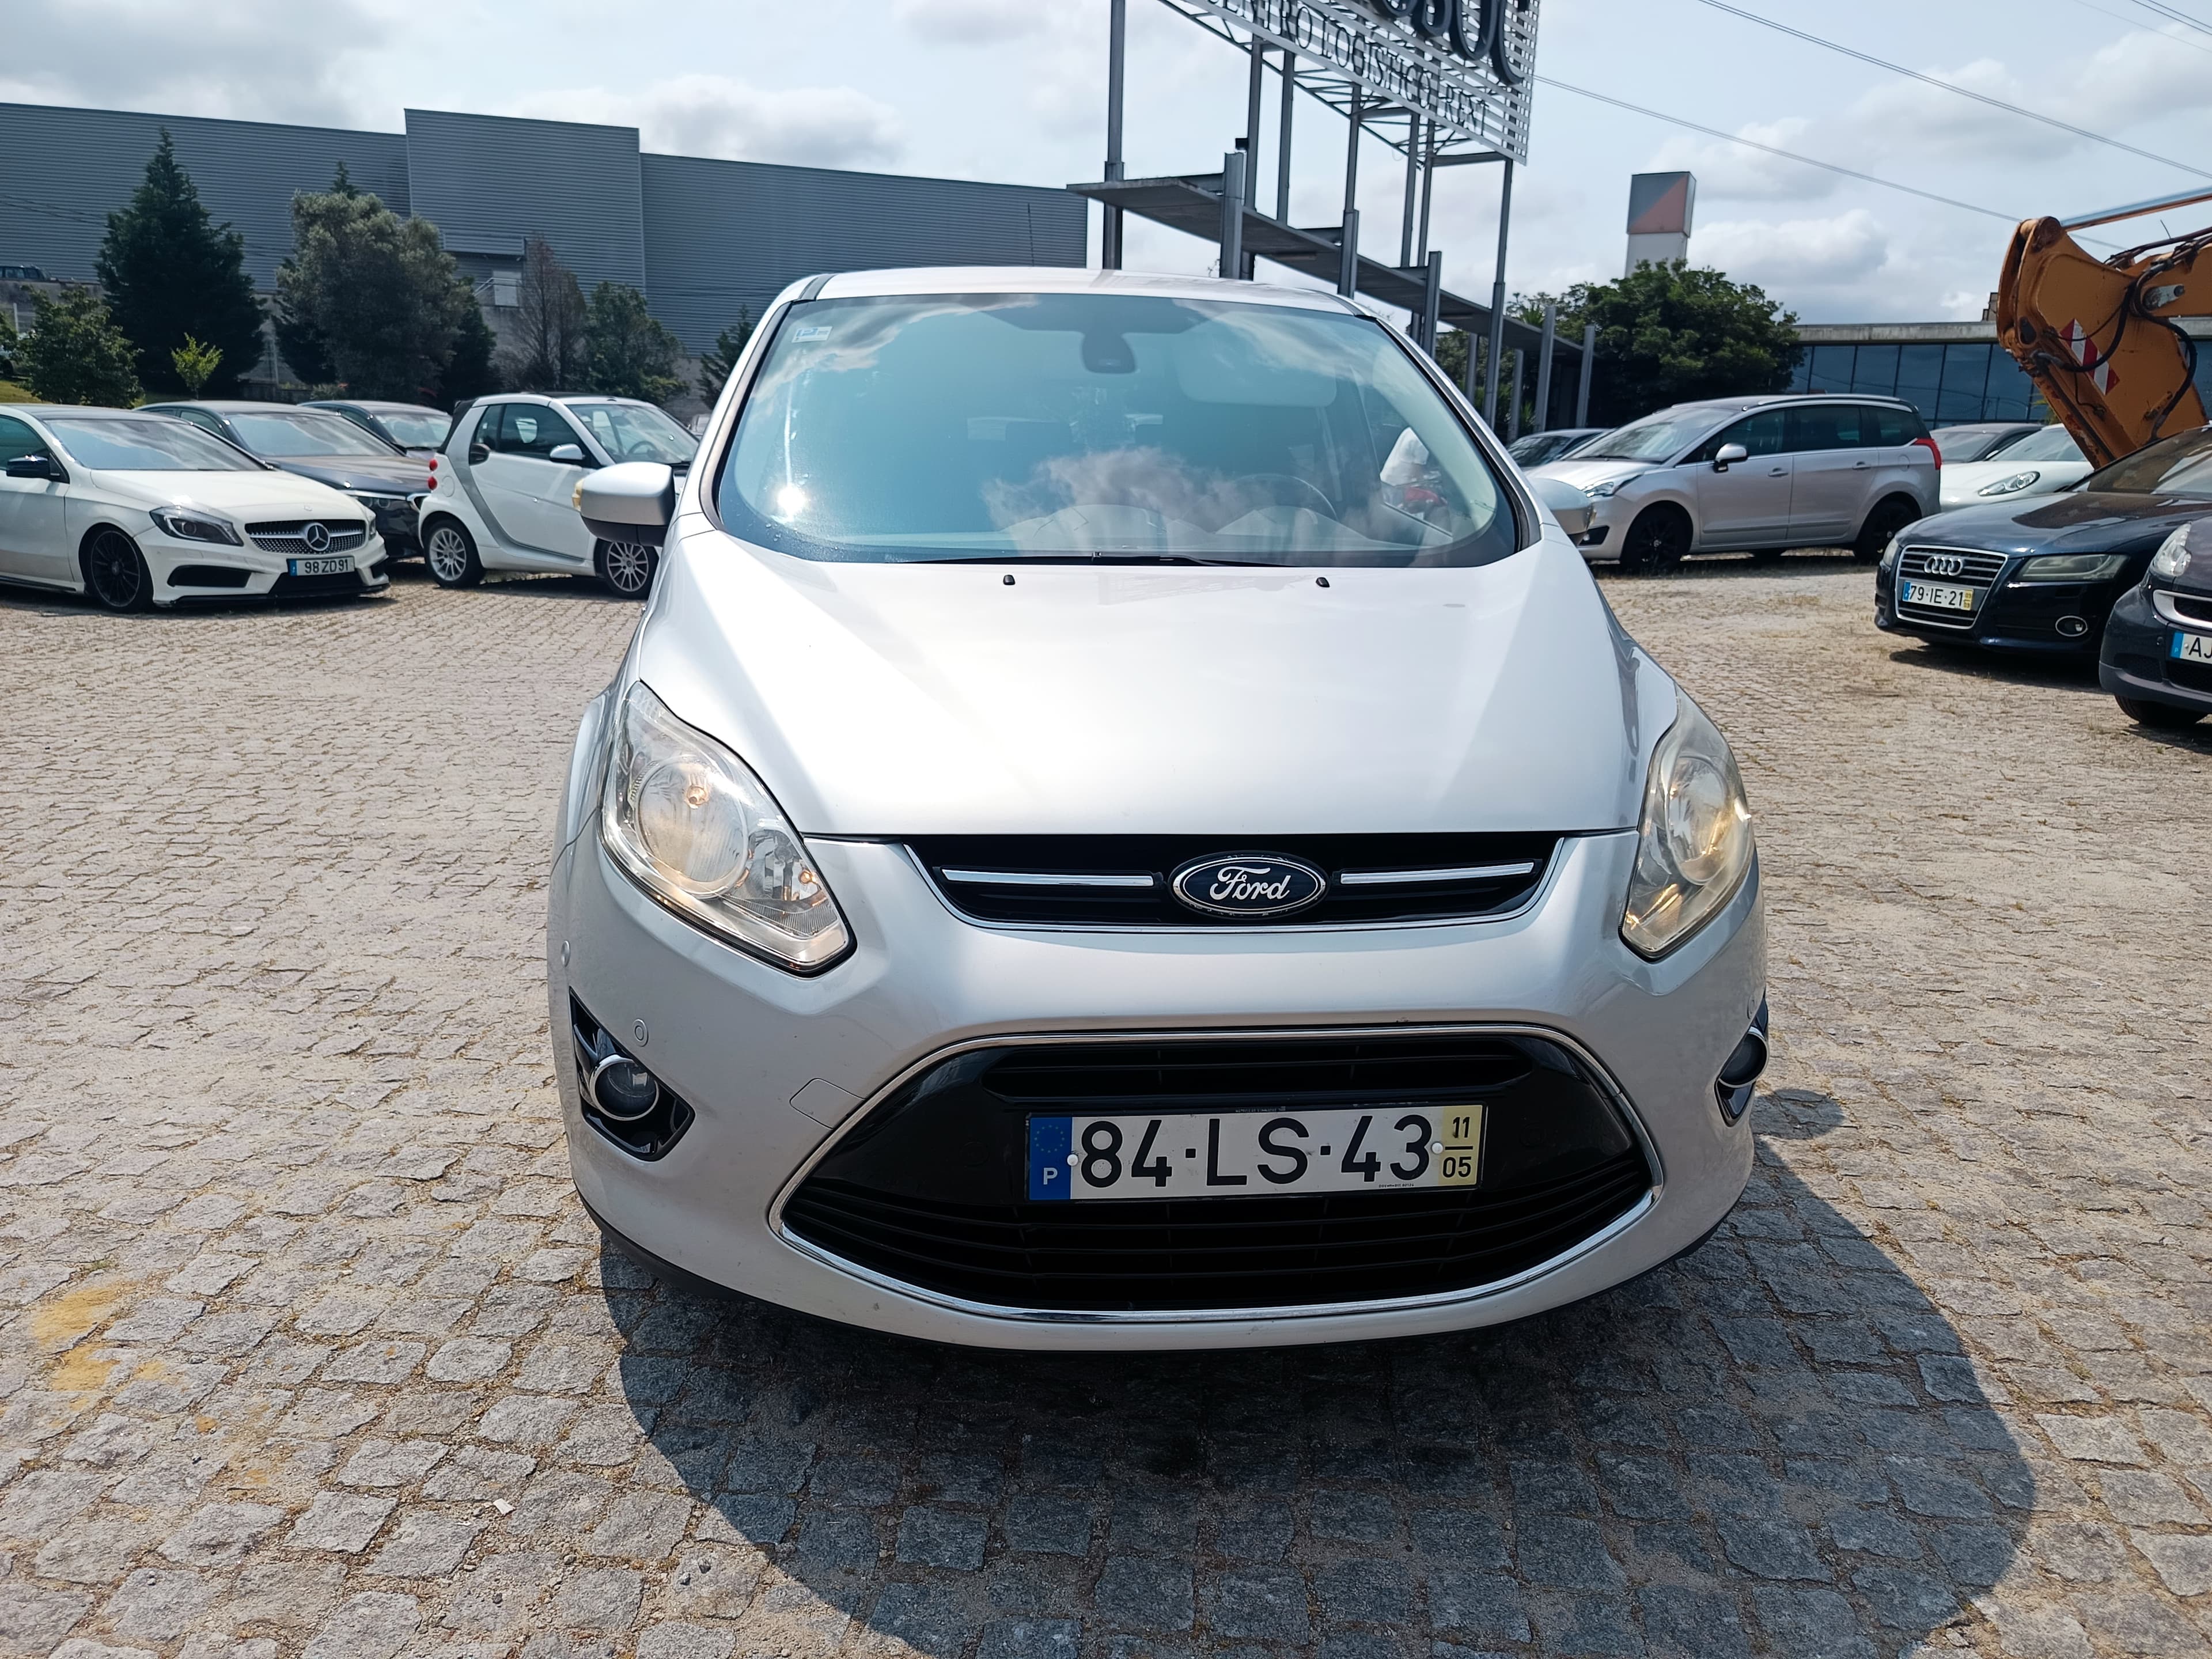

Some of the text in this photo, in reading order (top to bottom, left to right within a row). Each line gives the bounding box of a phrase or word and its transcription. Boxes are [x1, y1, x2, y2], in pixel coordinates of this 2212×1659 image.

[1209, 0, 1313, 49] NTRO
[1210, 866, 1291, 900] Ford
[1452, 1116, 1470, 1138] 11
[1043, 1167, 1058, 1185] P
[1442, 1156, 1472, 1178] 05
